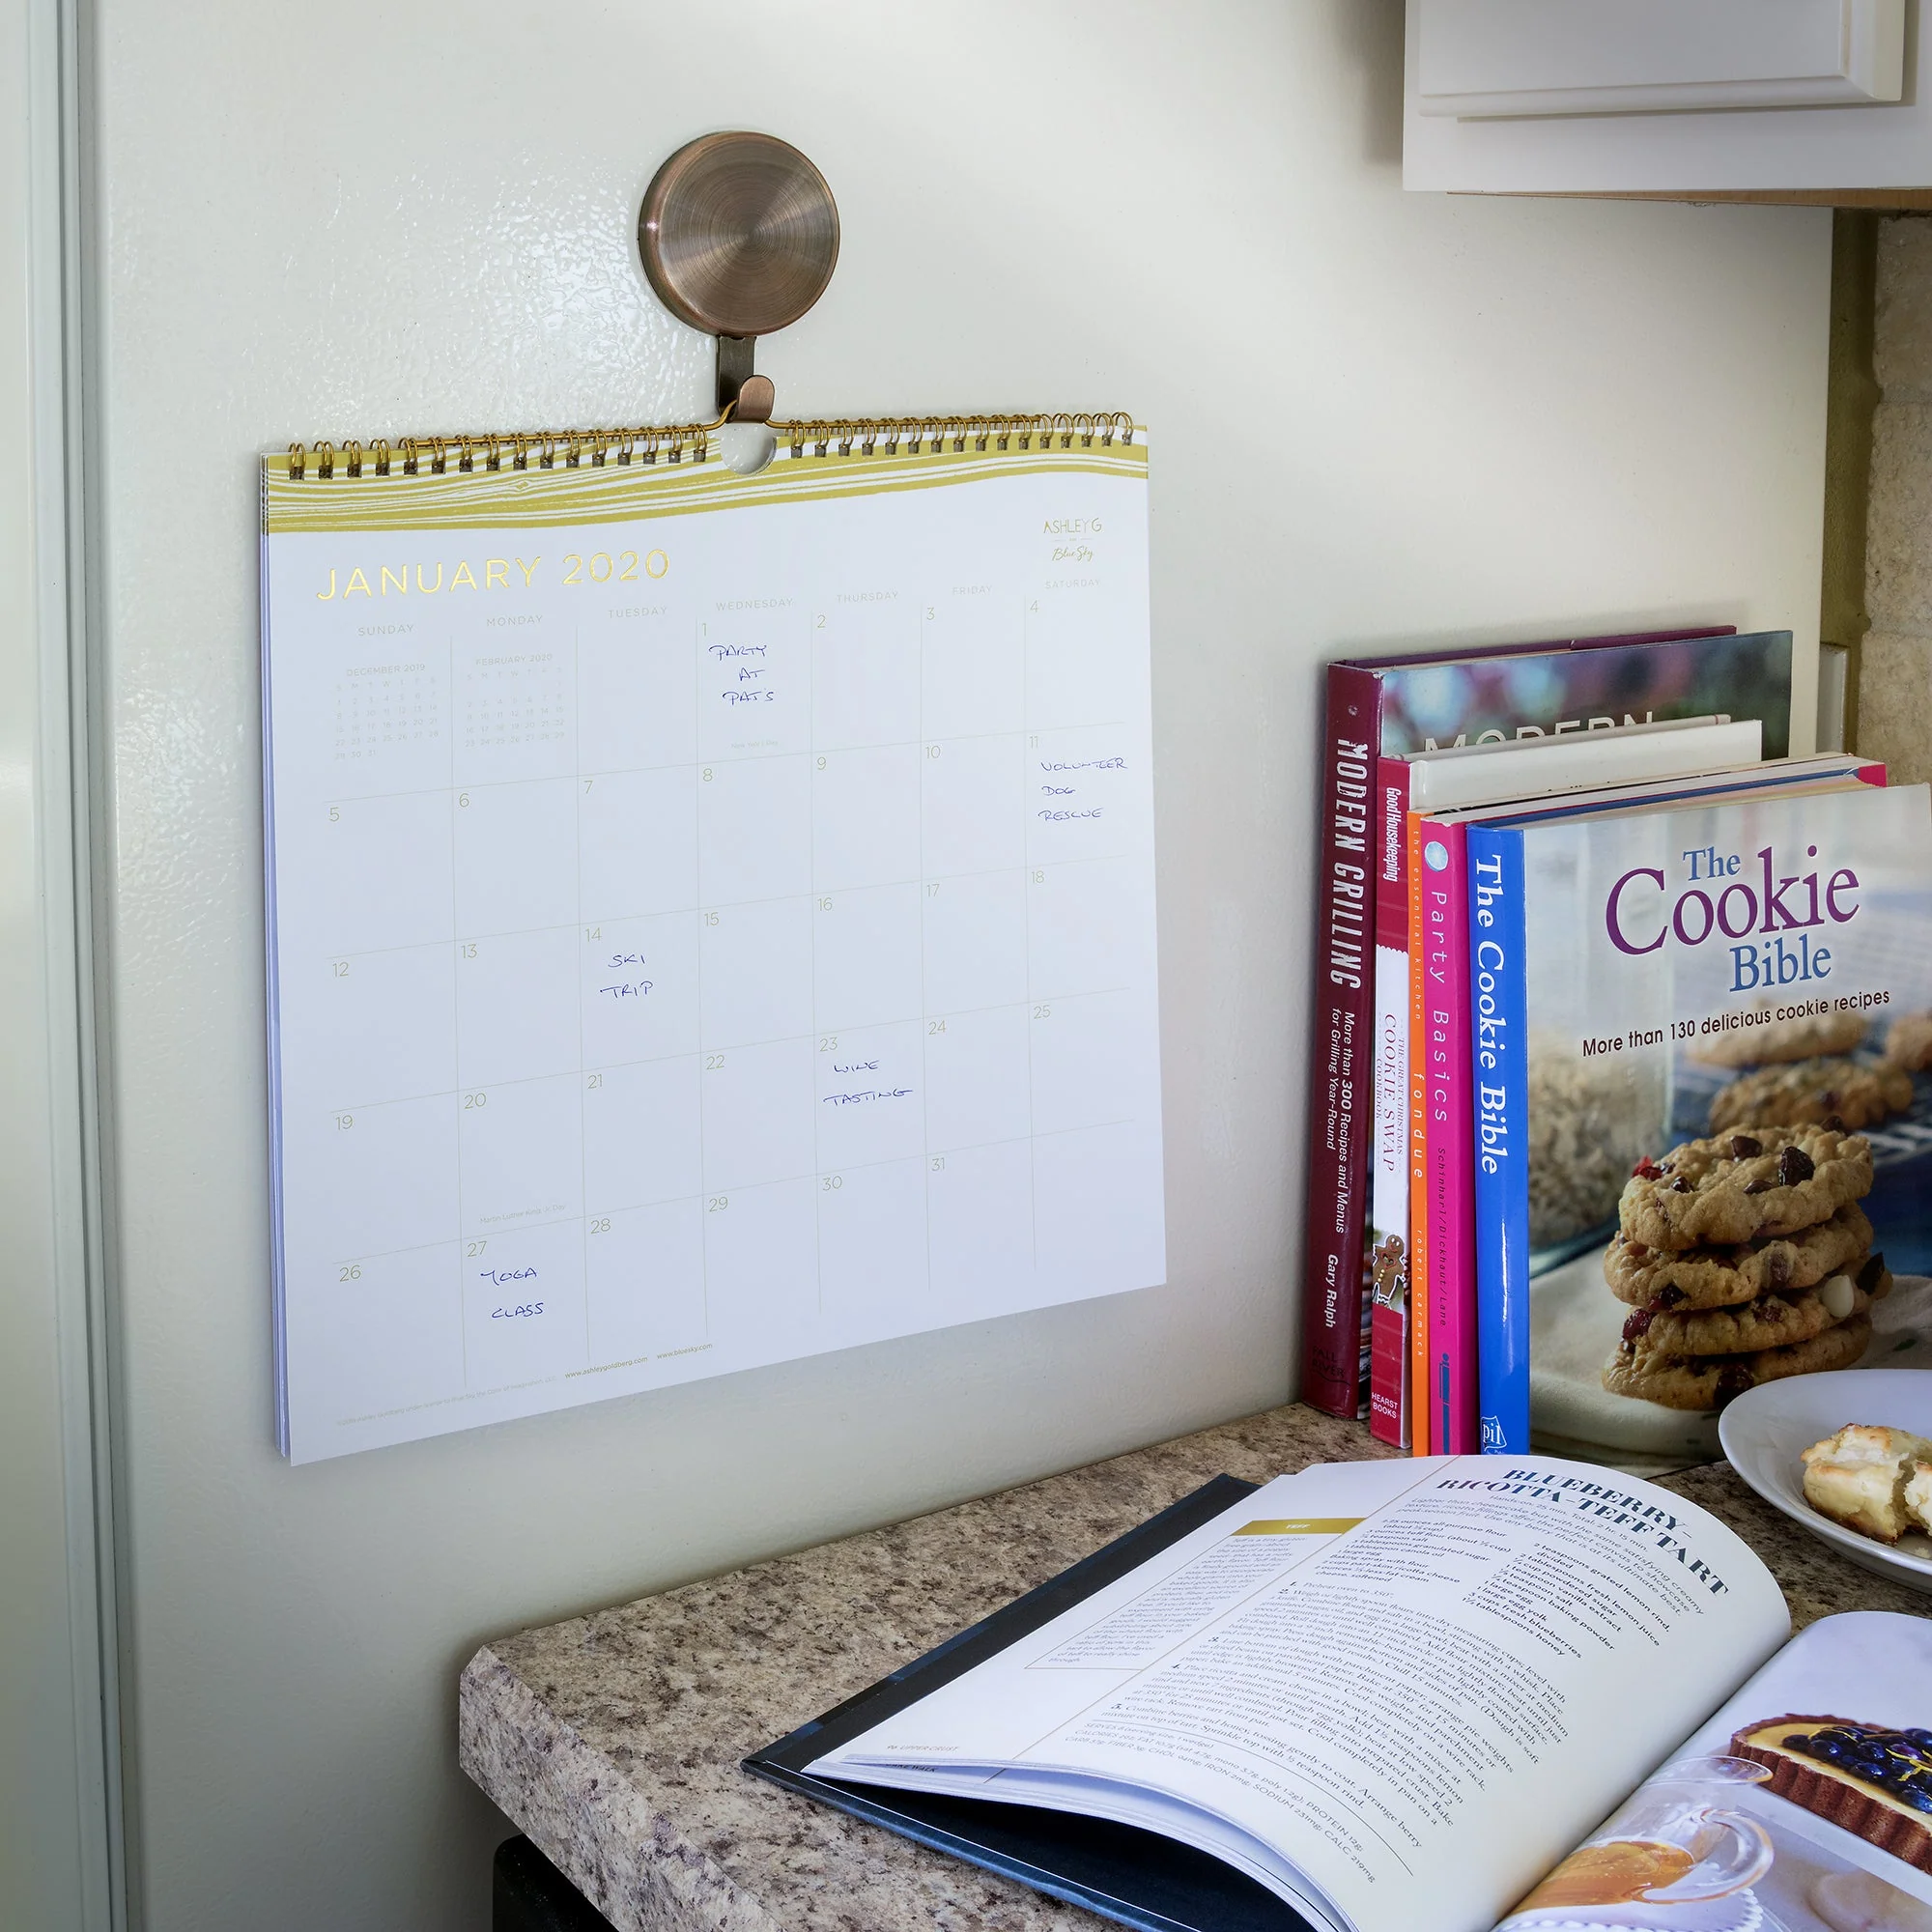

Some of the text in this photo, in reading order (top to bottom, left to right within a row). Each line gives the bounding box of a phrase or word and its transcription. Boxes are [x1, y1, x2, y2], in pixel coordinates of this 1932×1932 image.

[1043, 518, 1102, 533] ASHLEY G
[317, 549, 669, 601] JANUARY 2020
[357, 579, 1099, 636] SUNDAY MONDAY TUESDAY WEDNESDAY THURSDAY FRIDAY SATURDAY
[817, 615, 826, 629] 2
[926, 608, 935, 620] 3
[1030, 600, 1038, 613] 4
[709, 645, 767, 661] PARTY
[739, 668, 766, 681] AT
[329, 736, 1038, 822] 5 6 7 8 9 10 11
[1041, 786, 1076, 796] DOG
[1037, 808, 1103, 821] RESCUE
[1330, 738, 1368, 988] MODERN GRILLING
[1683, 847, 1741, 882] The
[332, 871, 1044, 977] 12 13 14 15 16 17 18
[1605, 844, 1861, 956] Cookie
[609, 954, 645, 968] SKI
[1729, 934, 1833, 992] Bible
[600, 980, 653, 999] TRIP
[1430, 891, 1450, 1122] Party Basics
[1476, 853, 1509, 1176] The Cookie Bible
[1582, 988, 1891, 1057] More than 130 delicious cookie recipes
[336, 1005, 1051, 1130] 19 20 21 22 23 24 25
[834, 1060, 879, 1074] WINE
[1326, 1008, 1341, 1150] for Grilling Year-Round
[1382, 1013, 1398, 1172] COOKIE SWAP
[823, 1088, 914, 1106] TASTING
[1336, 1011, 1356, 1234] More than 300 Recipes and Menus
[1412, 1072, 1425, 1179] fondue
[340, 1157, 945, 1282] 26 27 28 29 30 31
[480, 1267, 537, 1286] YOGA
[1415, 1229, 1424, 1282] robert
[491, 1302, 544, 1320] CLASS
[1324, 1254, 1339, 1329] Gary Ralph
[564, 1342, 714, 1380] www.ashleygoldberg.com www.bluesky.com
[1372, 1392, 1399, 1409] HEARST
[1373, 1403, 1398, 1419] BOOKS
[1537, 1551, 1574, 1570] divided
[1542, 1545, 1590, 1569] teaspoons
[1590, 1569, 1623, 1589] grated
[1624, 1587, 1651, 1612] lemon
[1617, 1562, 1660, 1593] ultimate
[1624, 1548, 1704, 1614] satisfying creamy
[1654, 1531, 1730, 1596] TART
[1482, 1587, 1548, 1623] large egg yolk
[1490, 1581, 1534, 1605] large egg
[1502, 1578, 1615, 1650] teaspoon baking powder
[1509, 1573, 1573, 1607] teaspoon salt
[1512, 1566, 1622, 1633] teaspoon vanilla extract
[1523, 1562, 1618, 1617] cup powdered sugar
[1527, 1555, 1584, 1584] tablespoons
[1586, 1583, 1611, 1602] fresh
[1612, 1600, 1640, 1626] lemon
[1638, 1624, 1661, 1647] juice
[1645, 1572, 1690, 1612] showcase
[1476, 1602, 1534, 1634] tablespoons
[1535, 1633, 1565, 1656] honey
[1477, 1595, 1499, 1607] cups
[1502, 1605, 1527, 1621] fresh
[1528, 1617, 1581, 1659] blueberries
[1358, 1787, 1422, 1848] Arrange berry
